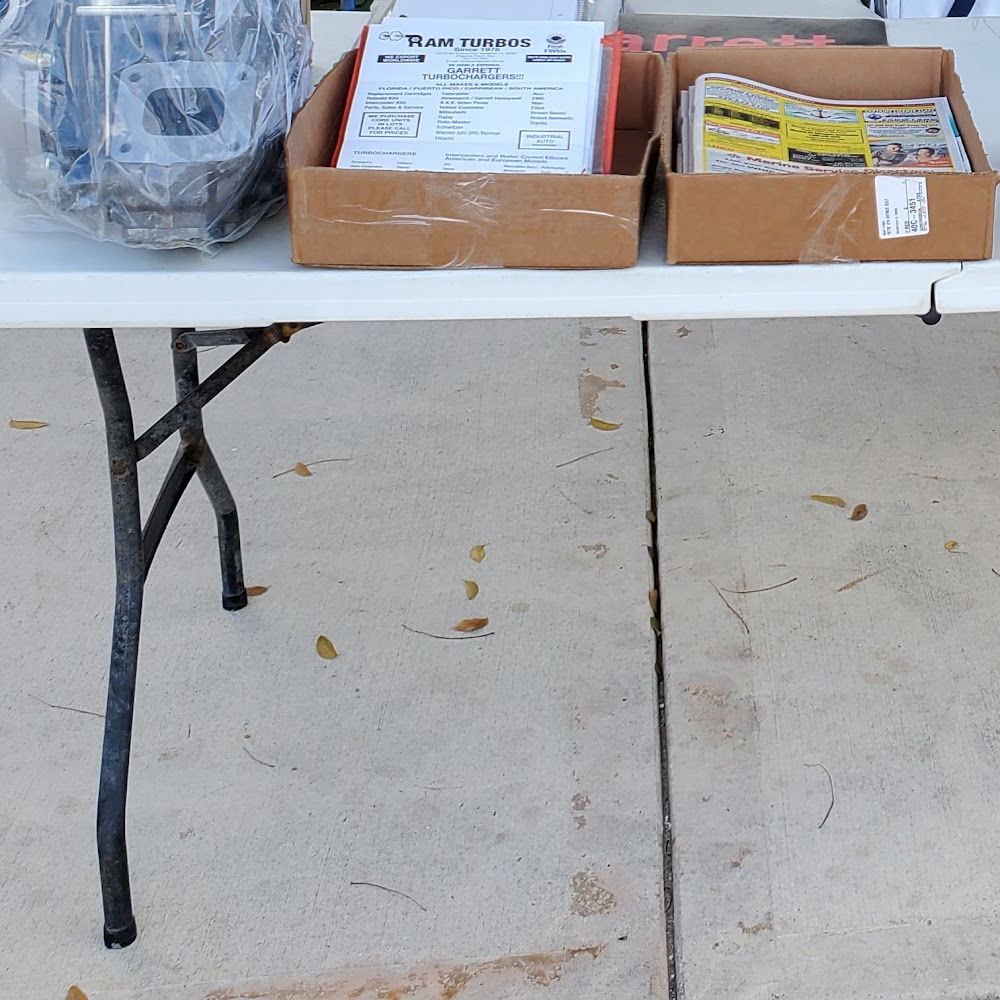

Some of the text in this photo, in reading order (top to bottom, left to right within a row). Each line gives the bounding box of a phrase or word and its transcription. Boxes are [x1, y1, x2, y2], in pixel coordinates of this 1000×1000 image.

[405, 34, 532, 48] RAM TURBOS
[746, 155, 800, 169] Marine
